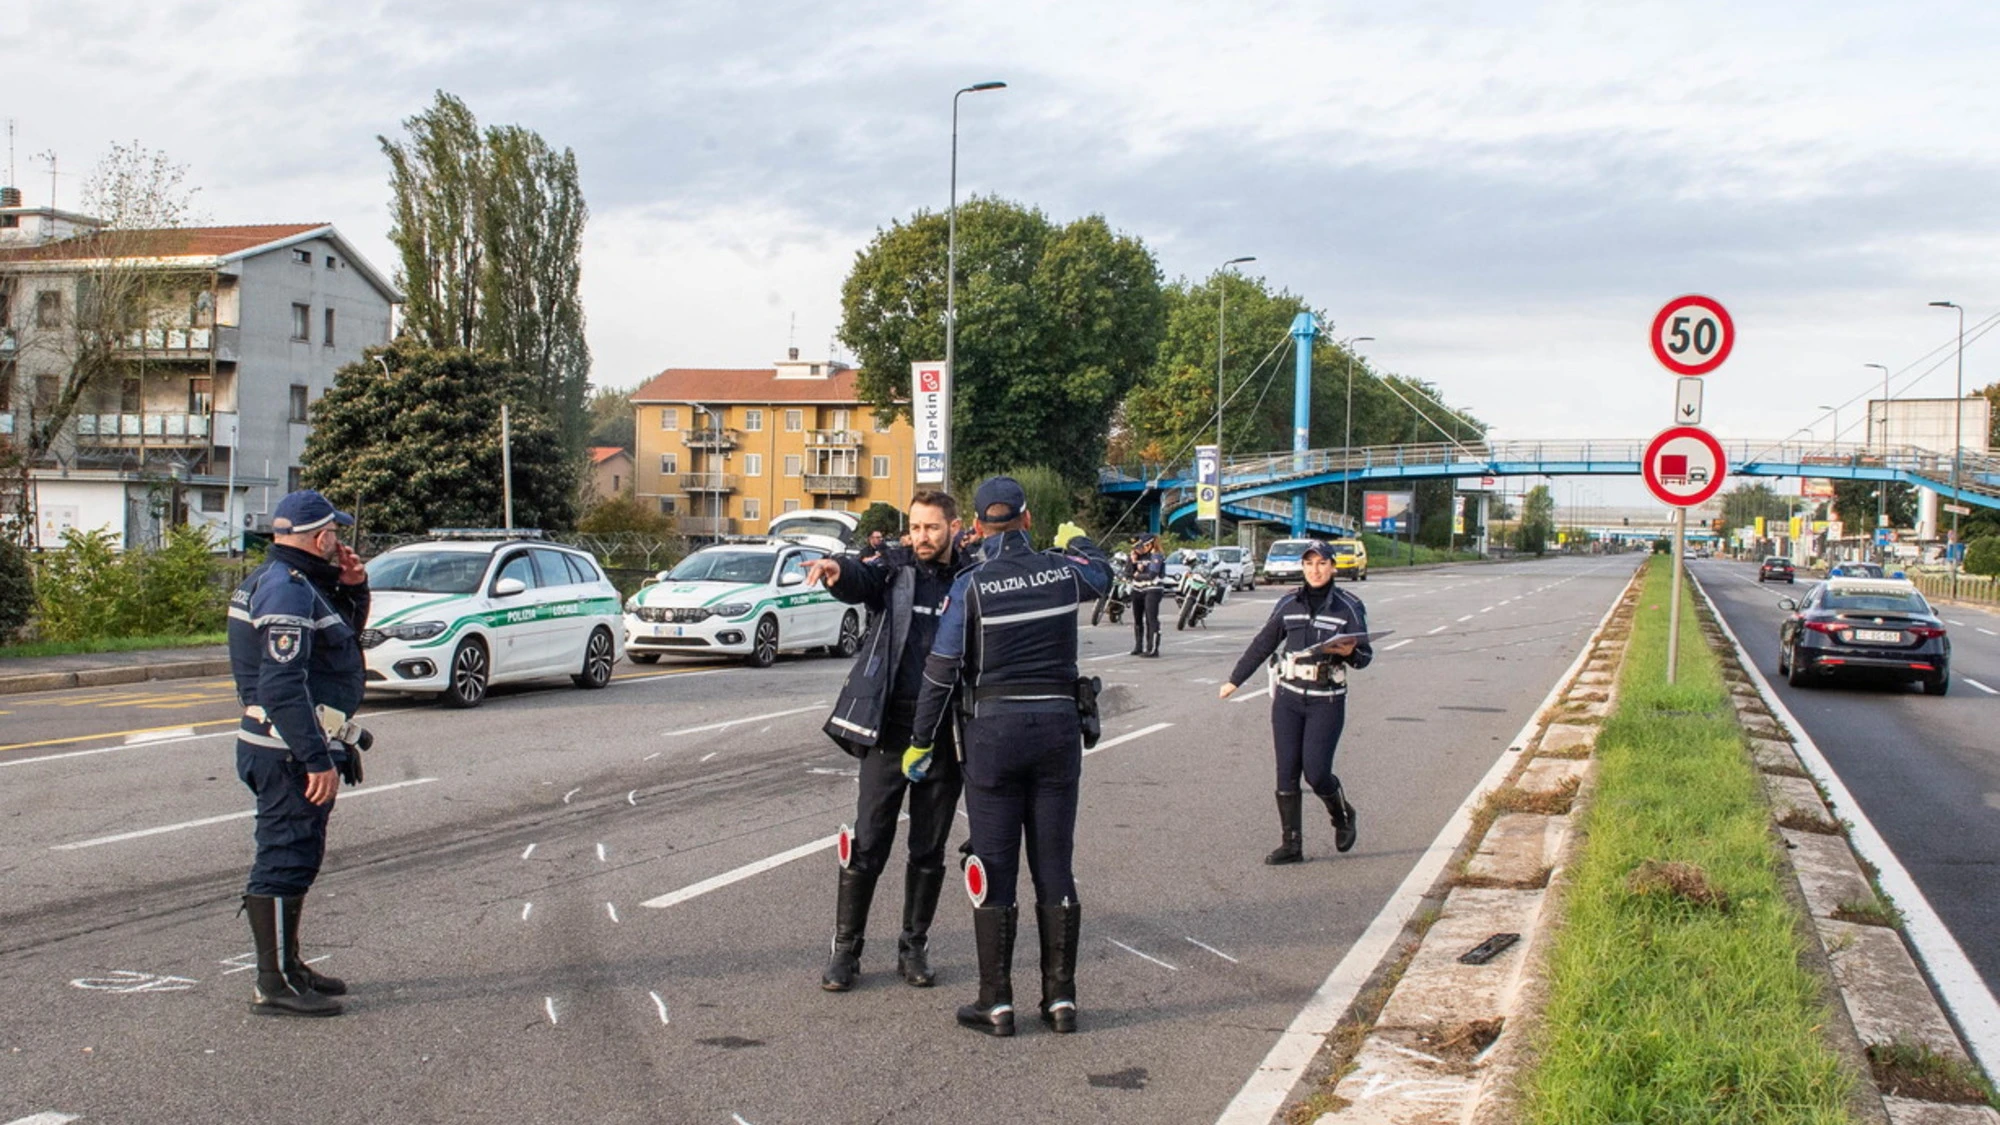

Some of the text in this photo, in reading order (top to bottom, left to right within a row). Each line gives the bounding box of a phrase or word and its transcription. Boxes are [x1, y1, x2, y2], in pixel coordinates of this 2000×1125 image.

[1668, 316, 1717, 355] 50
[980, 566, 1072, 594] POLIZIA LOCALE
[507, 608, 536, 623] POLIZIA
